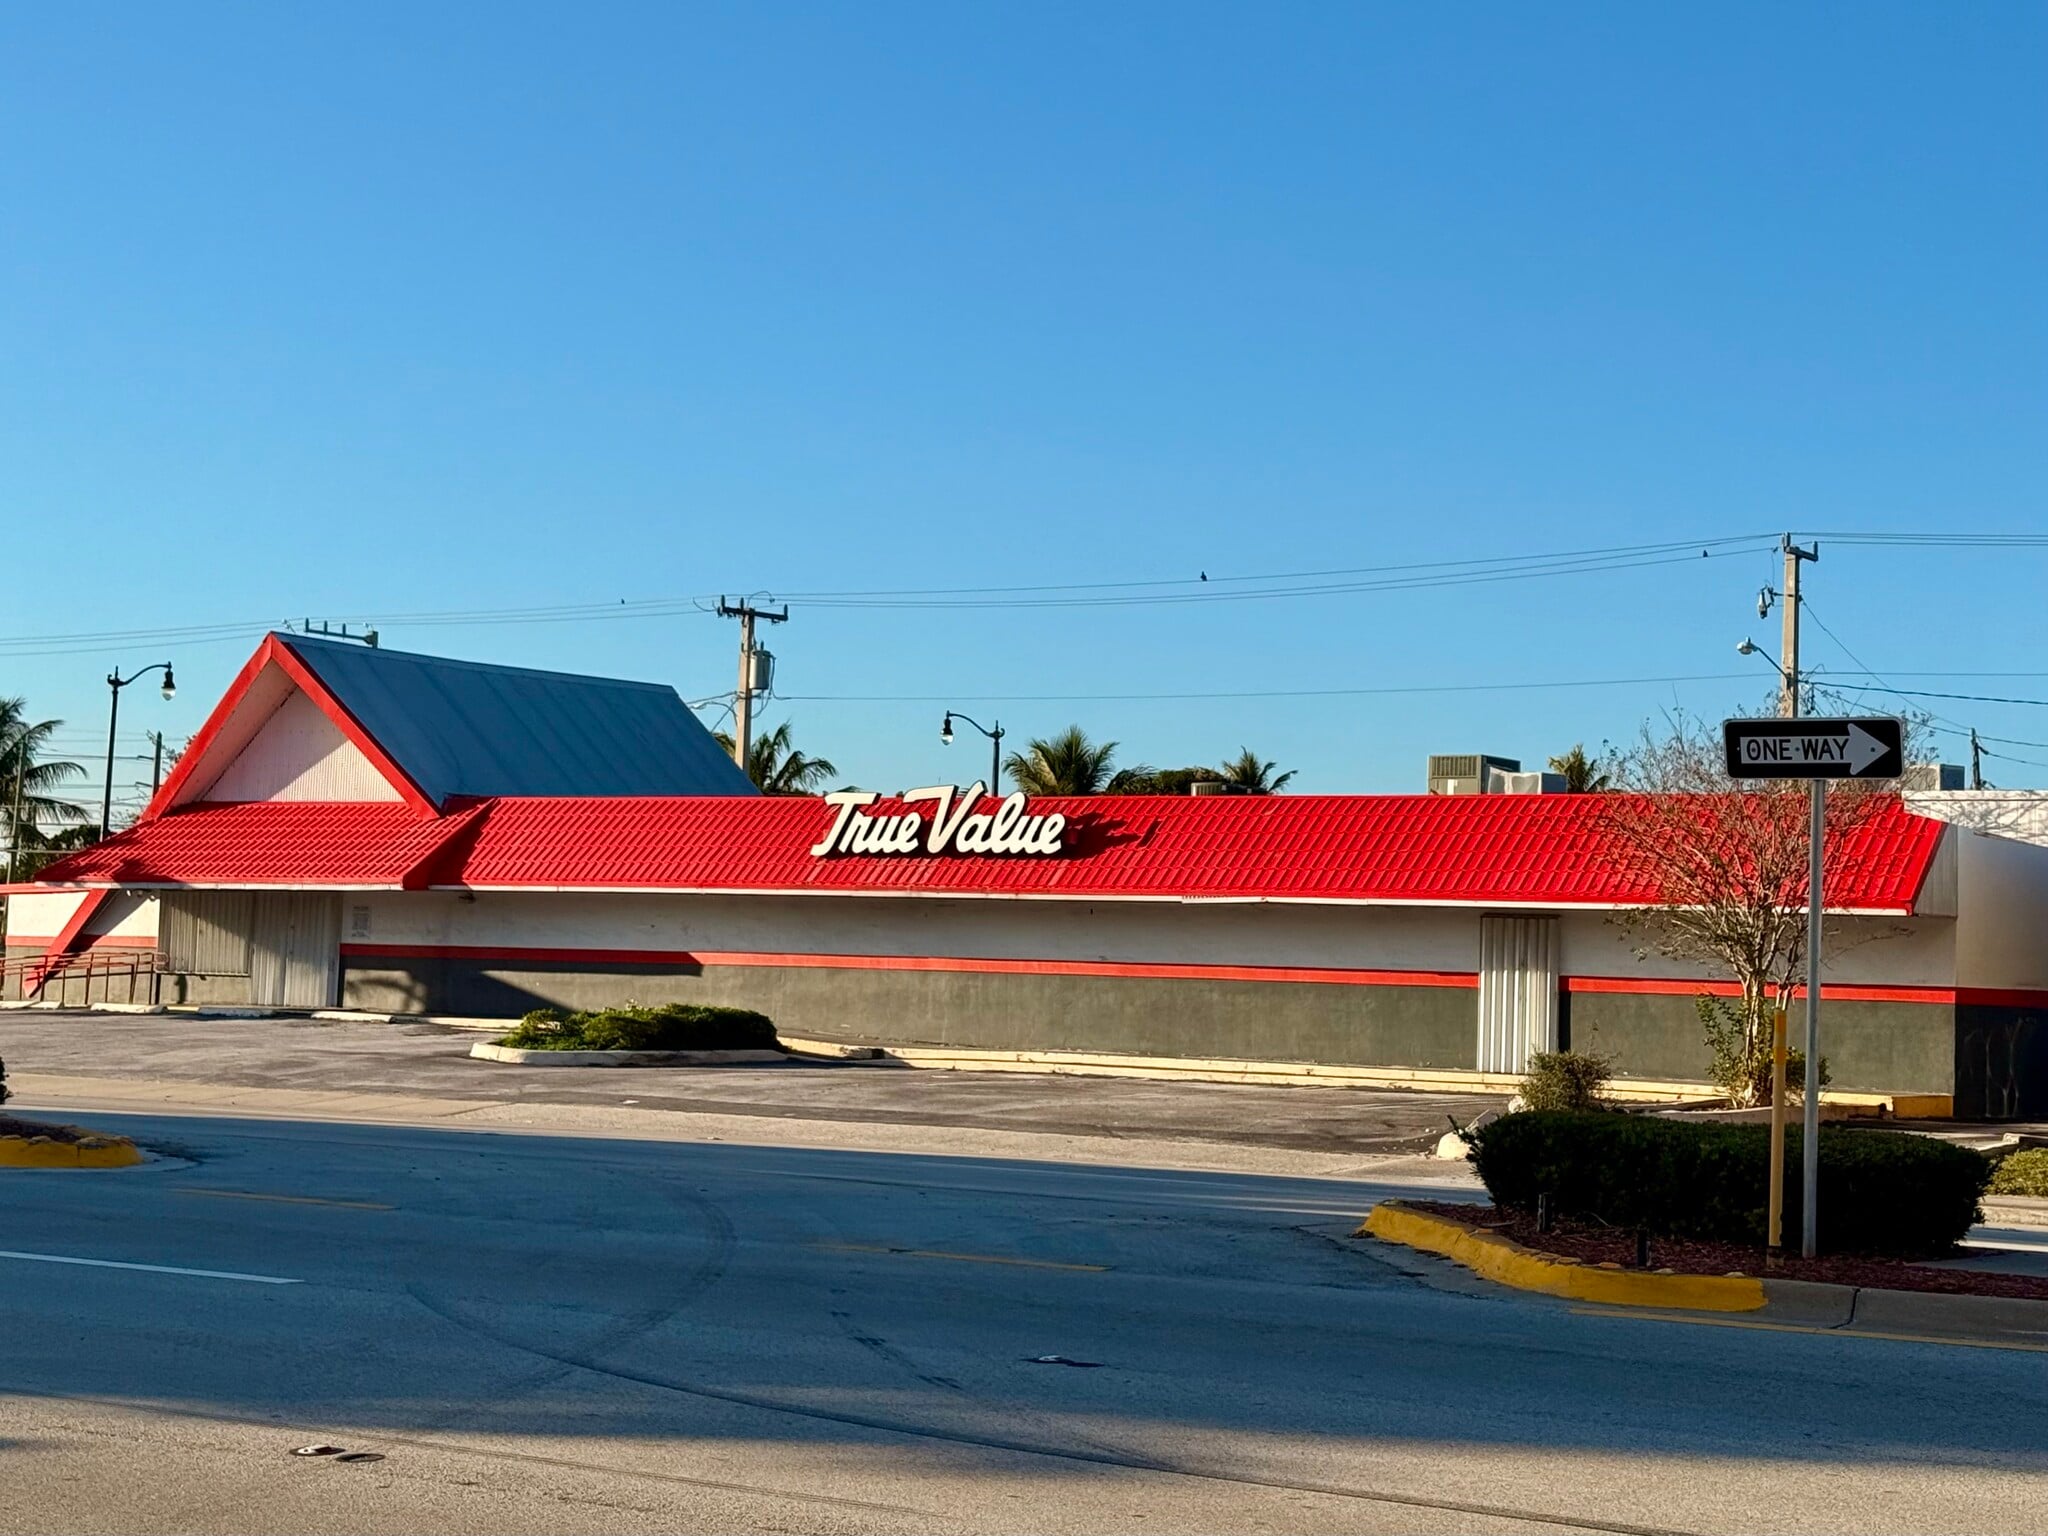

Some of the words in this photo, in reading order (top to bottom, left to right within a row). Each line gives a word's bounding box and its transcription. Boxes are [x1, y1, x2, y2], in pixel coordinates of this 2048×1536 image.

[1746, 739, 1793, 761] ONE
[1801, 738, 1849, 761] WAY
[810, 792, 922, 855] True
[903, 780, 1066, 855] Value
